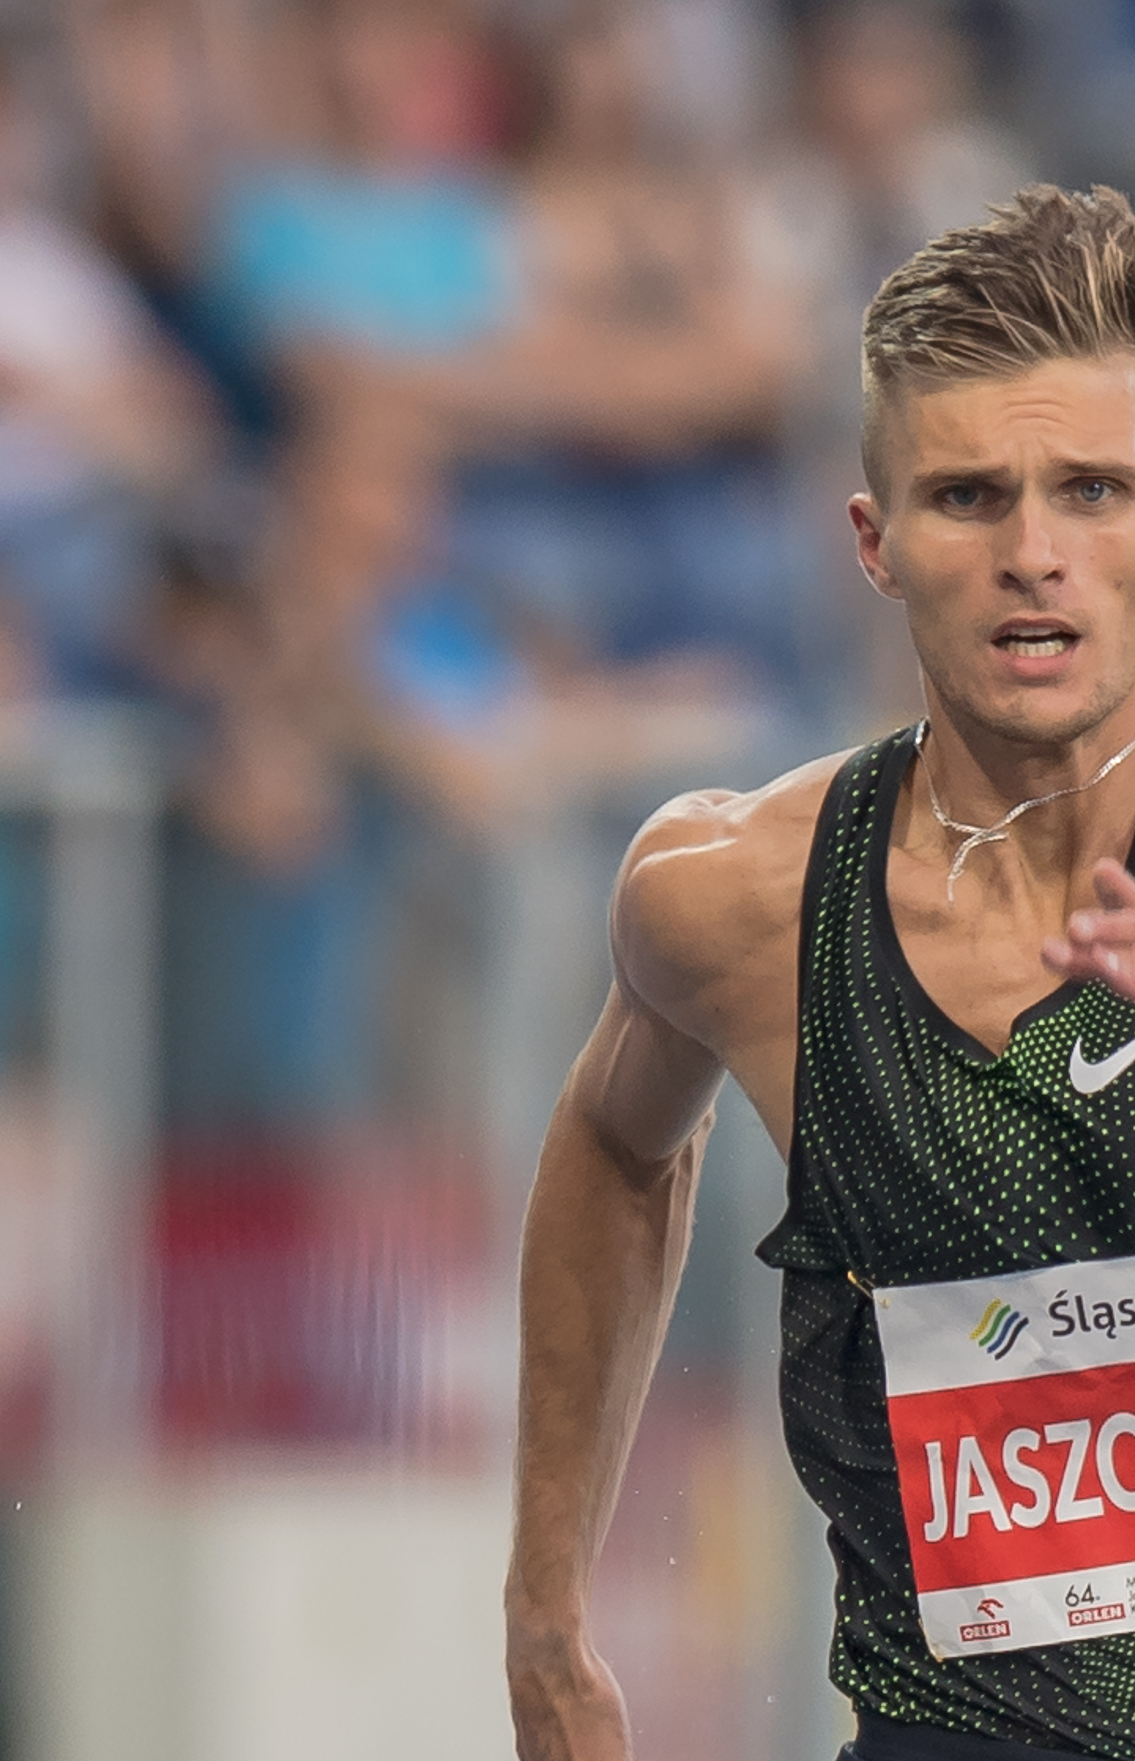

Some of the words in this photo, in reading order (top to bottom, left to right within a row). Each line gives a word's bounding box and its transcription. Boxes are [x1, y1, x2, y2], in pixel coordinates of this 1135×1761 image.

[1065, 1583, 1101, 1607] 64.
[1070, 1605, 1123, 1624] ORLEN
[962, 1622, 1008, 1640] ORLEN
